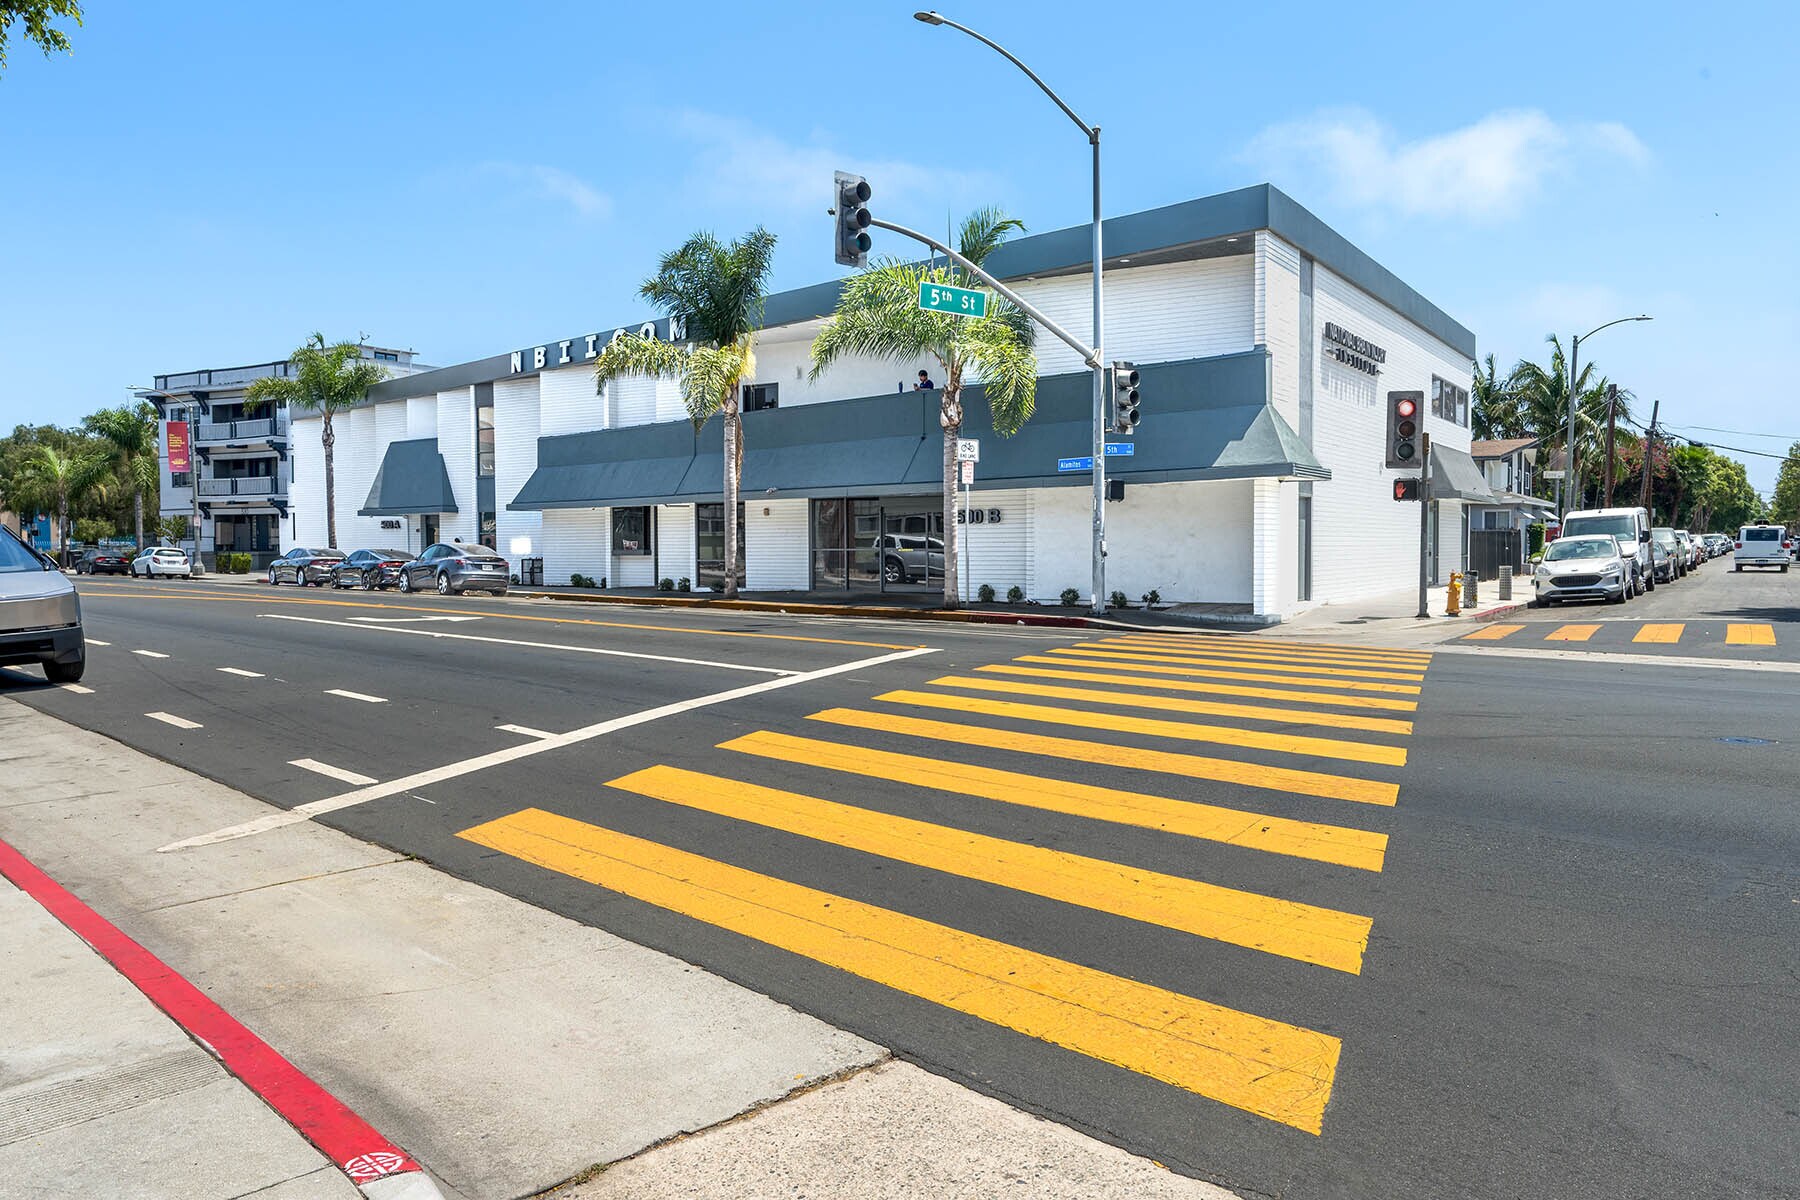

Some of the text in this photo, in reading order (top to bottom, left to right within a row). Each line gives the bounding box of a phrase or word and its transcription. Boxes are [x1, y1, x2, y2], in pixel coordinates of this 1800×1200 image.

[930, 288, 976, 311] 5th St
[1107, 445, 1118, 454] 5th
[988, 508, 1001, 524] B
